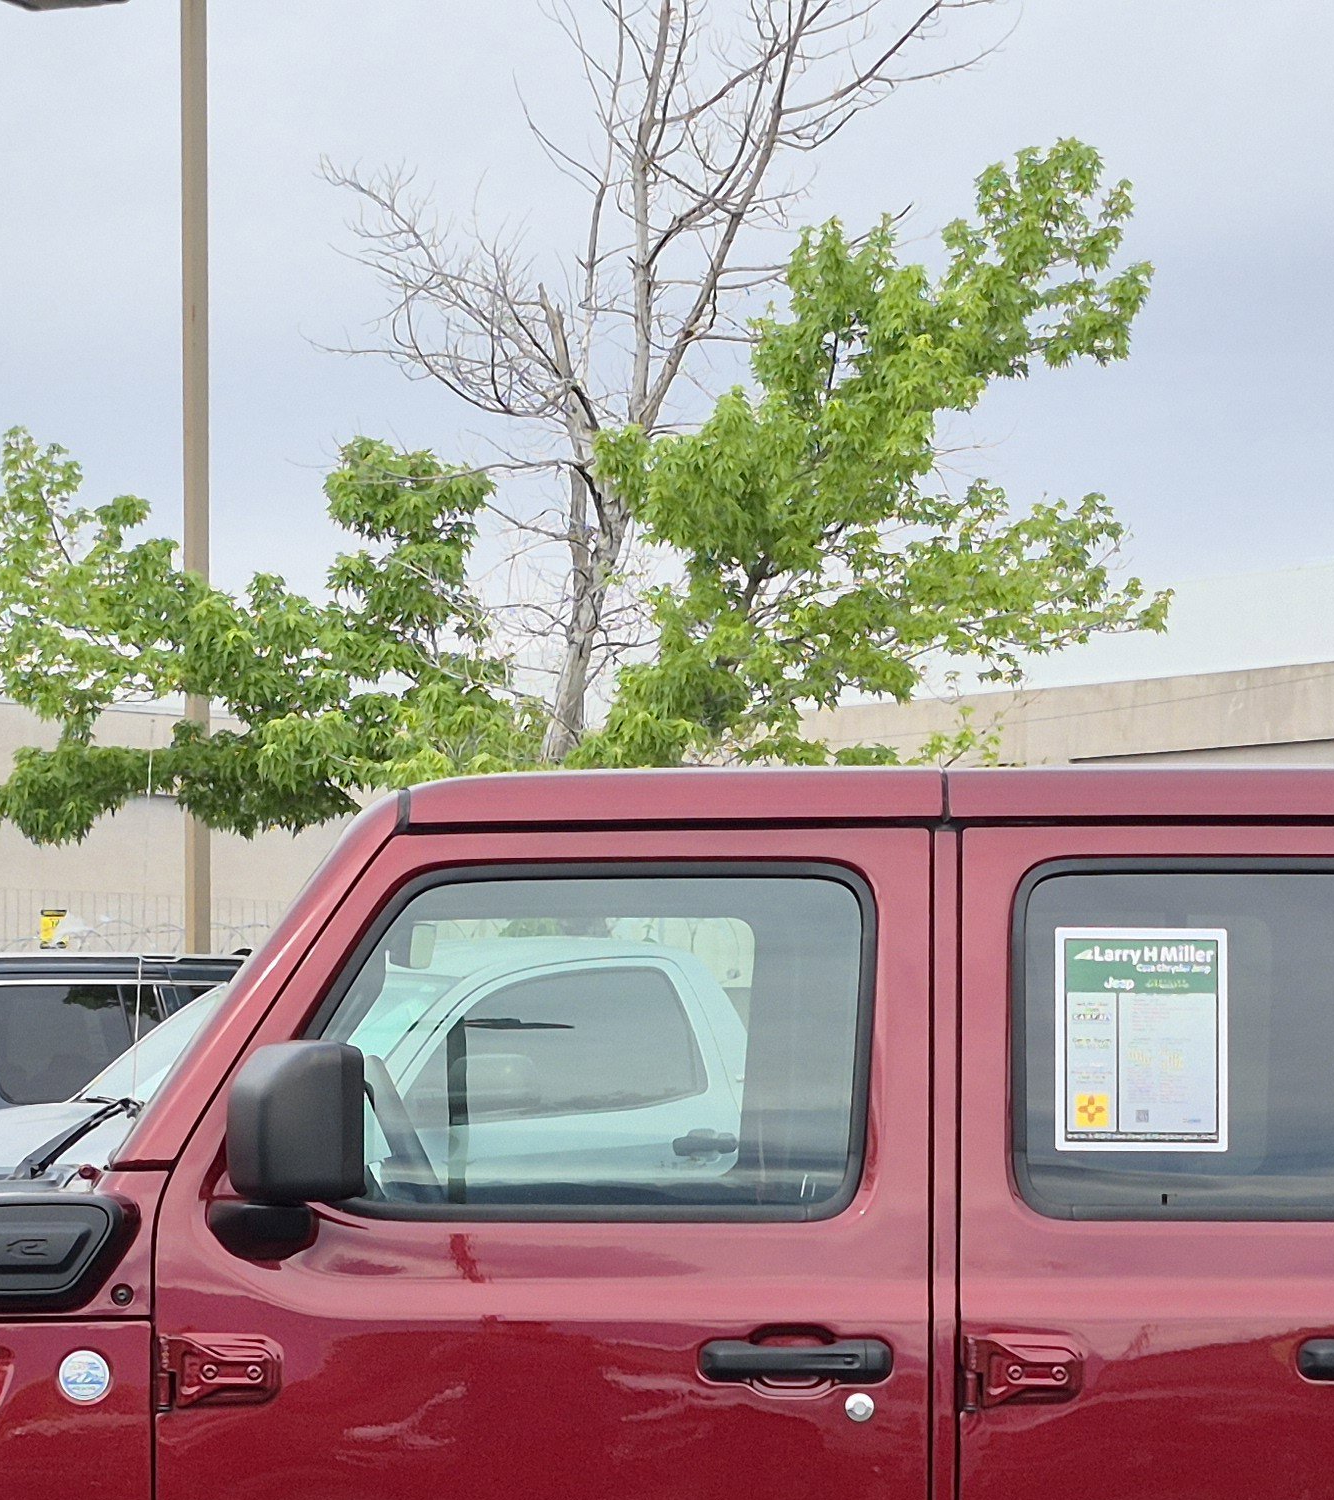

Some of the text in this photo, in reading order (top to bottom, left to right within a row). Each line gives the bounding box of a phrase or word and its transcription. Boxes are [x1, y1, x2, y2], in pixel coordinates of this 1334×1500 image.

[1094, 944, 1214, 965] Larry H Miller
[1104, 976, 1135, 990] Jeep
